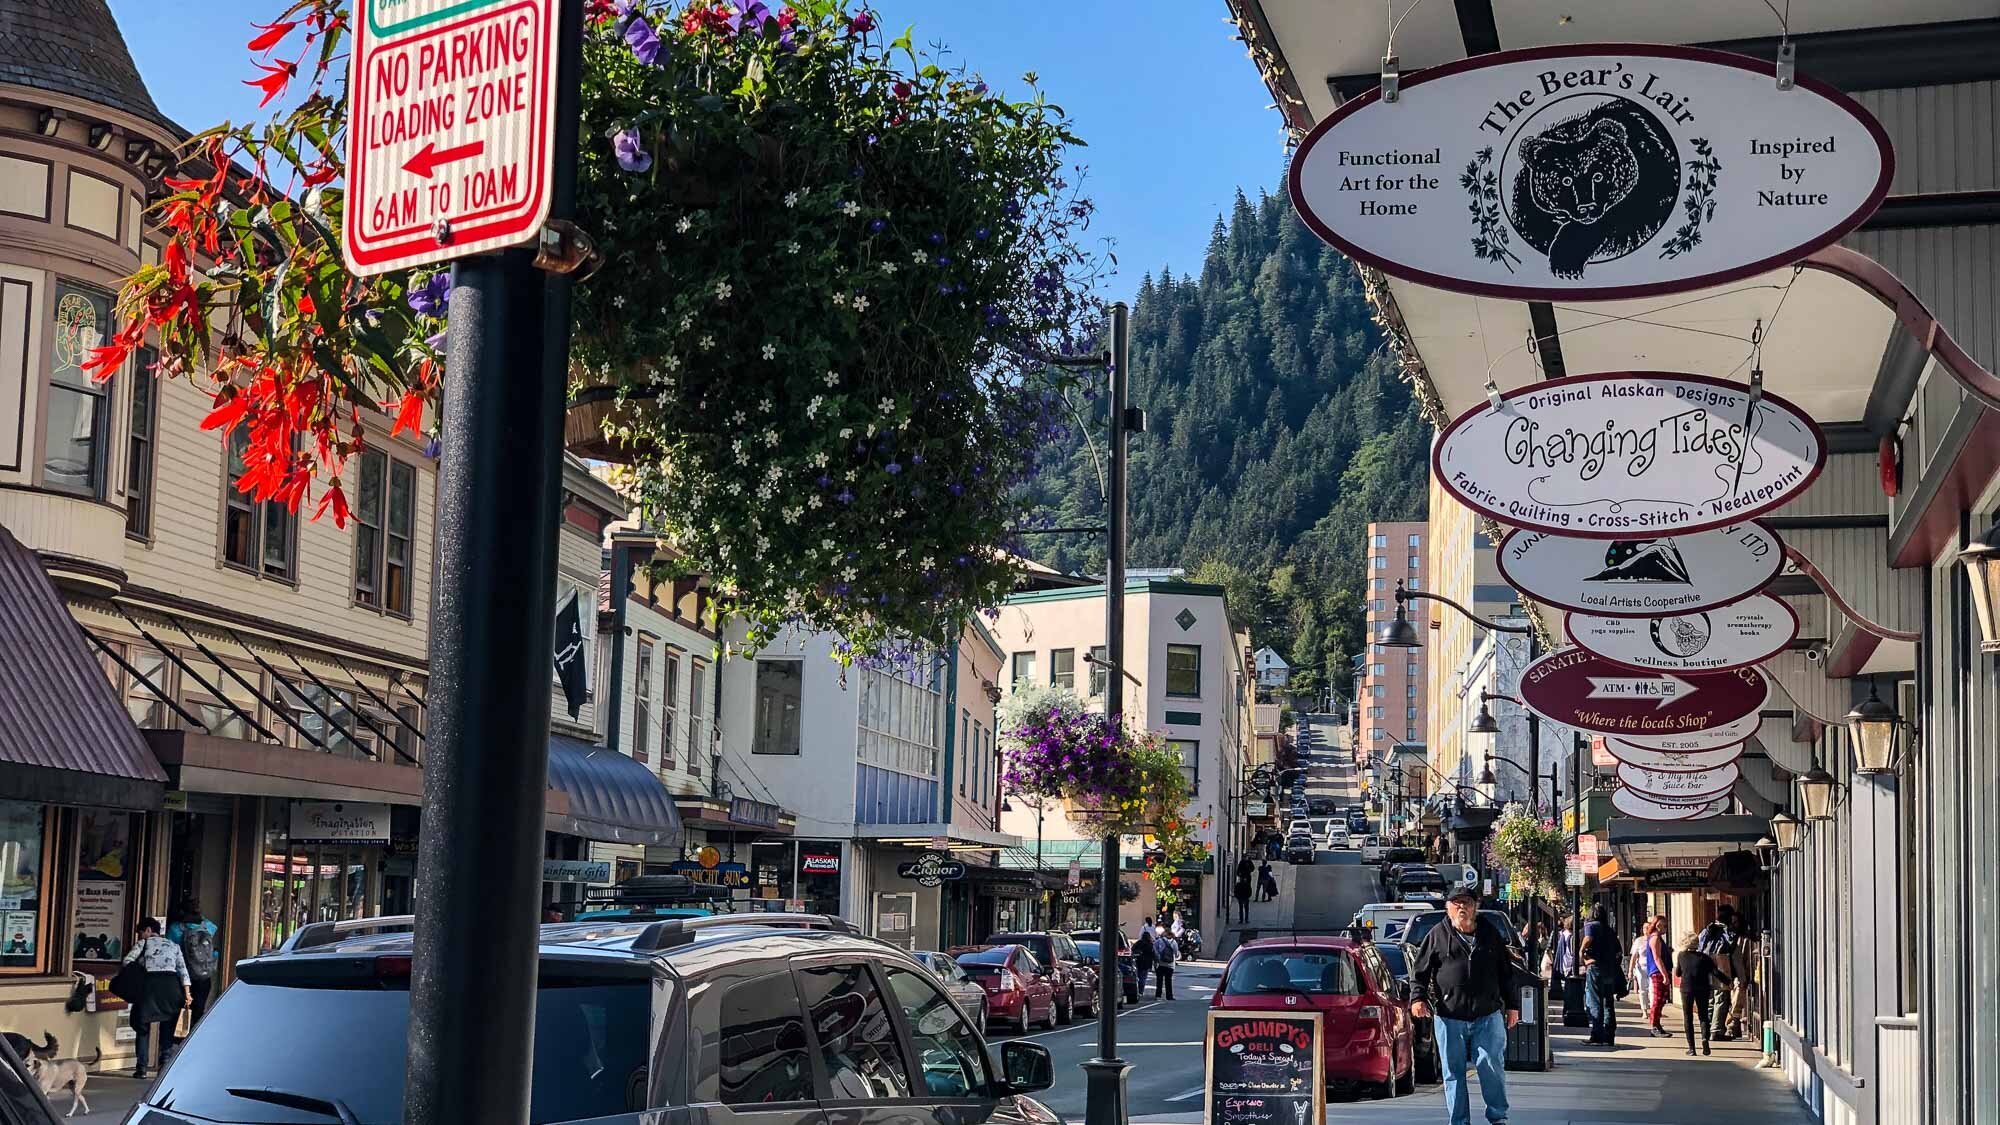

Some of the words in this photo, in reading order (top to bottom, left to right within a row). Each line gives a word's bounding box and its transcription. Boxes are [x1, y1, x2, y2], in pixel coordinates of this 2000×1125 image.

[376, 52, 409, 103] NO
[418, 15, 529, 91] PARKING
[1479, 89, 1536, 137] The
[1536, 62, 1635, 97] Bear's
[1640, 74, 1697, 127] Lair
[370, 92, 456, 150] LOADING
[464, 72, 527, 125] ZONE
[1750, 135, 1835, 158] Inspired
[1338, 148, 1440, 166] Functional
[1340, 176, 1370, 191] Art
[1375, 174, 1403, 191] for
[1408, 173, 1439, 190] the
[1781, 164, 1805, 185] by
[373, 187, 418, 232] 6AM
[429, 183, 450, 216] TO
[463, 162, 518, 212] 10AM
[1758, 189, 1828, 207] Nature
[1360, 200, 1417, 216] Home
[1528, 386, 1592, 411] Original
[1601, 384, 1665, 397] Alaskan
[1675, 385, 1737, 408] Designs
[1504, 415, 1658, 481] Changing
[1659, 408, 1743, 463] Tides
[1453, 470, 1497, 506] Fabric
[1508, 503, 1571, 527] Quilting
[1587, 507, 1690, 528] Cross-Stitch
[1711, 463, 1805, 515] Needlepoint
[1739, 533, 1769, 563] LTD.
[1580, 591, 1607, 606] Local
[1609, 594, 1643, 608] Artists
[1643, 591, 1702, 608] Cooperative
[1529, 651, 1587, 684] SENATE
[1682, 656, 1728, 669] boutique
[1602, 683, 1625, 693] ATM
[1662, 684, 1676, 694] WC
[1619, 715, 1638, 728] the
[1641, 714, 1675, 729] locals
[1679, 741, 1700, 749] 2005
[315, 816, 375, 831] Imagination
[802, 857, 839, 872] ALASKAN
[919, 854, 943, 865] ALASKA
[723, 870, 741, 888] SUN
[902, 864, 958, 876] Liquor
[1217, 1021, 1310, 1049] GRUMPY'S
[1248, 1042, 1274, 1052] DELI
